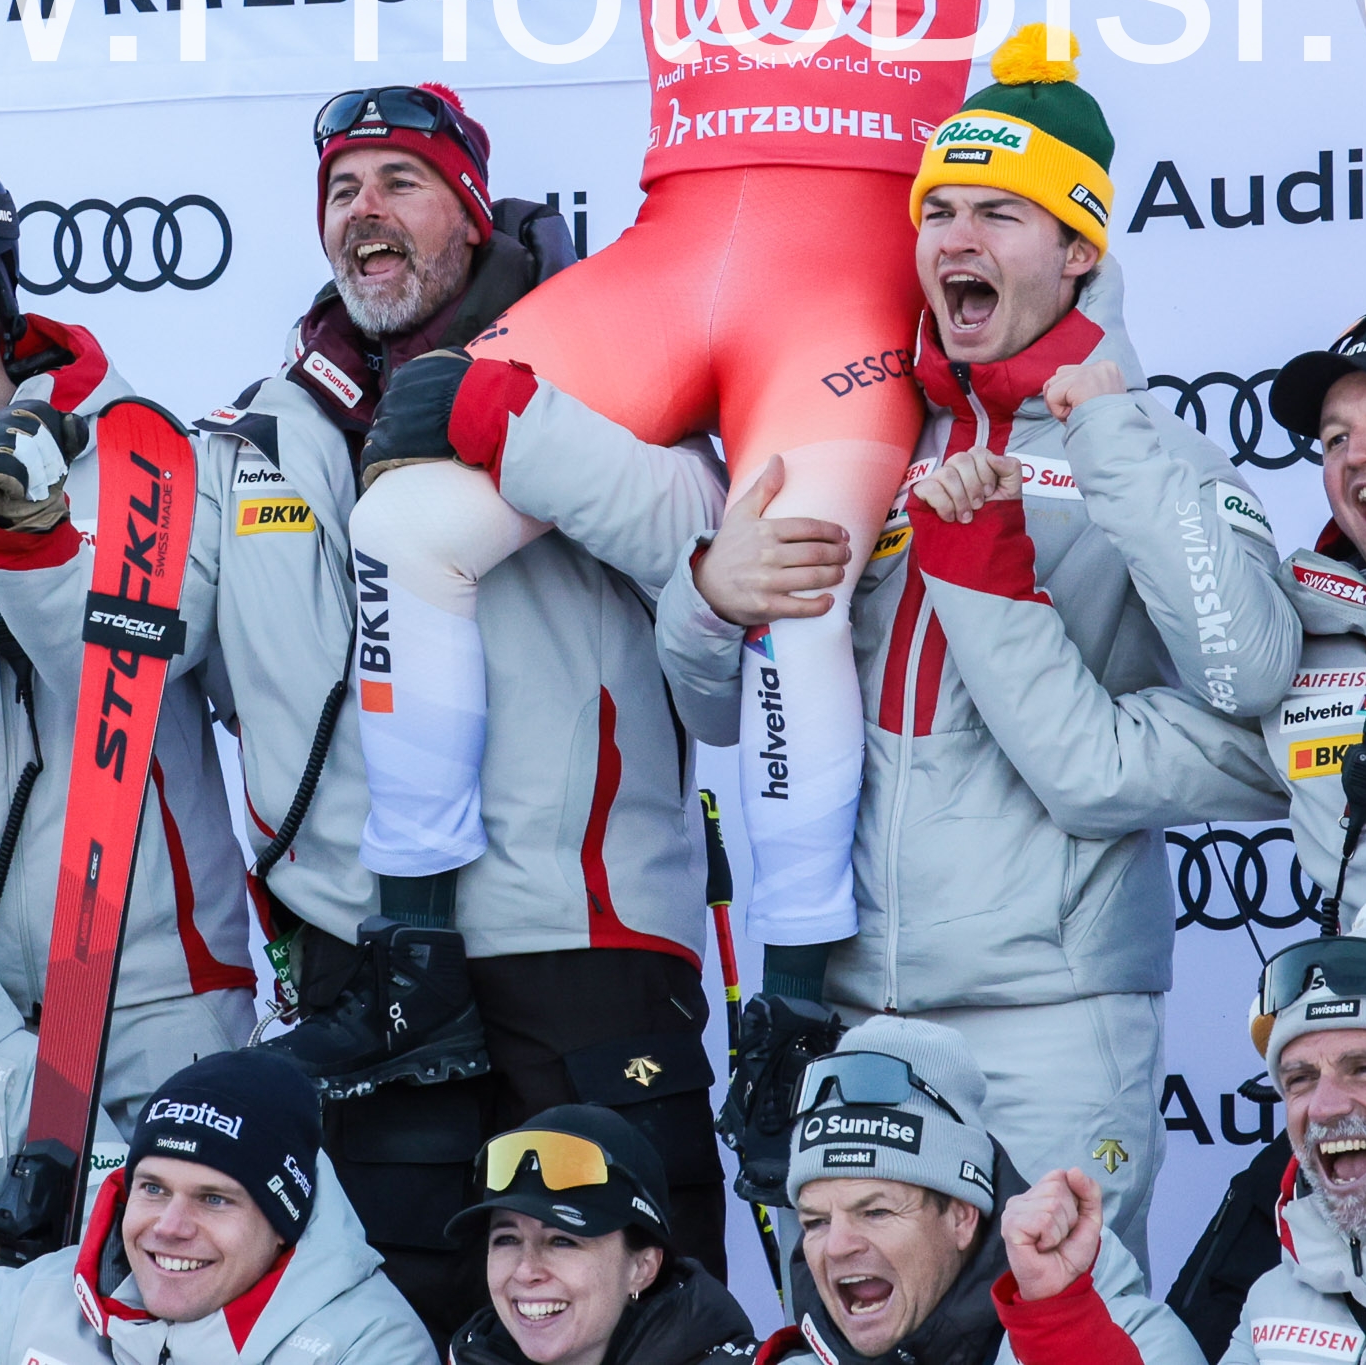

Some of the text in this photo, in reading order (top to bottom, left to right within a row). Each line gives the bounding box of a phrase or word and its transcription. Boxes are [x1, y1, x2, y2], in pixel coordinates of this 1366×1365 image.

[656, 49, 922, 92] Audi FIS Ski World Cup
[936, 120, 1022, 149] Ricola
[948, 150, 987, 161] swissski
[1127, 148, 1364, 233] Audi
[322, 367, 356, 402] Sunrise
[258, 506, 310, 524] BKW
[154, 484, 173, 578] SWISS MADE
[1176, 501, 1237, 654] swissski
[89, 610, 167, 637] STÖCKLI
[355, 548, 392, 674] BKW
[1284, 700, 1354, 725] helvetia
[761, 667, 789, 800] helvetia
[1315, 744, 1347, 767] BK
[1311, 1002, 1354, 1017] swissski
[826, 1115, 915, 1143] Sunrise
[156, 1137, 197, 1153] swissski
[828, 1151, 871, 1164] swissski
[276, 1189, 301, 1222] reusch
[1253, 1324, 1357, 1352] RAIFFEISEN
